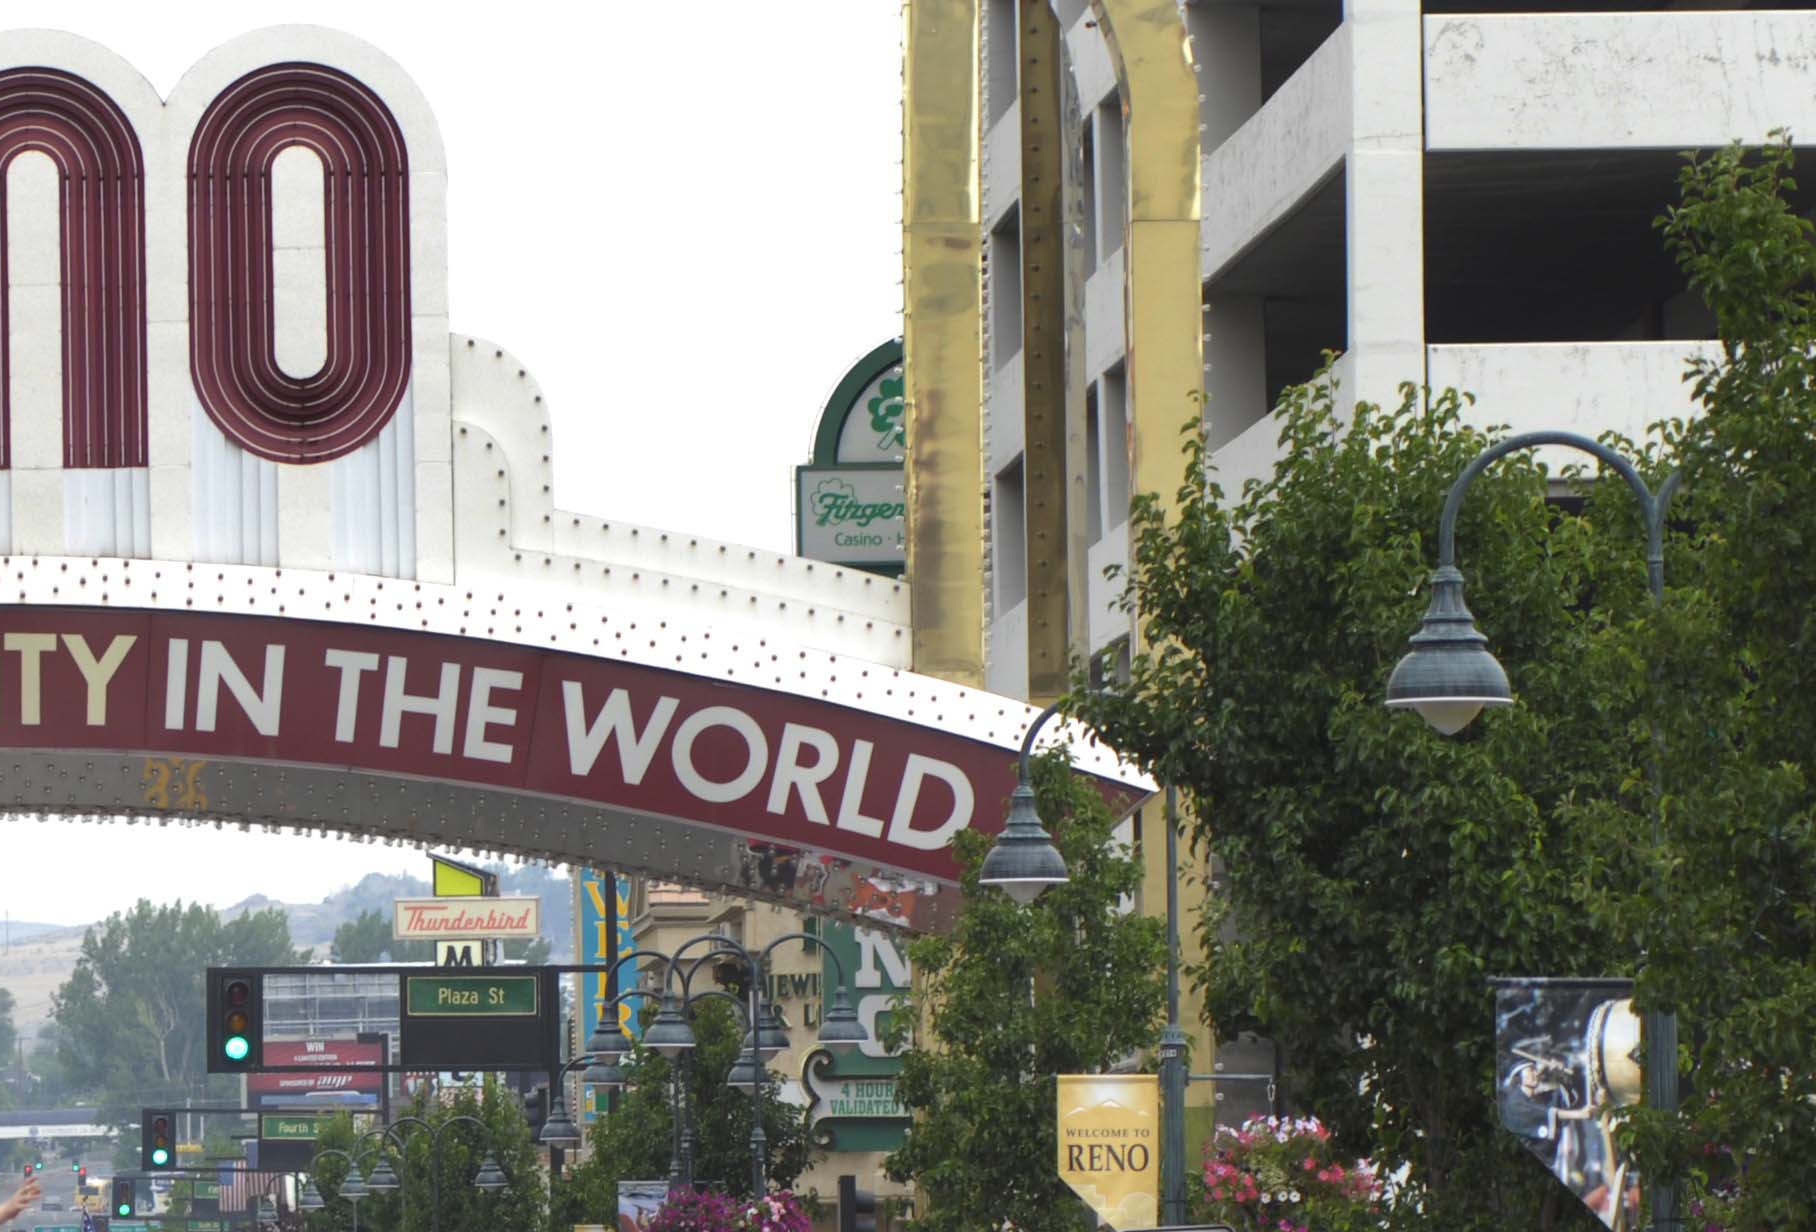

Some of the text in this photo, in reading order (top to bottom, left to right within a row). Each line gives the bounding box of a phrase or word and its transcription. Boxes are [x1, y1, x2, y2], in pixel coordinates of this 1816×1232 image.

[818, 493, 905, 527] Fitzger
[834, 531, 882, 546] Casino
[163, 636, 286, 737] IN
[324, 648, 525, 764] THE
[561, 679, 975, 852] WORLD
[403, 905, 531, 932] Thunderbird
[438, 986, 505, 1005] Plaza St
[840, 1082, 850, 1098] 4
[278, 1121, 309, 1133] Fourth
[1065, 1127, 1151, 1138] WELCOME TO
[1067, 1143, 1150, 1173] RENO
